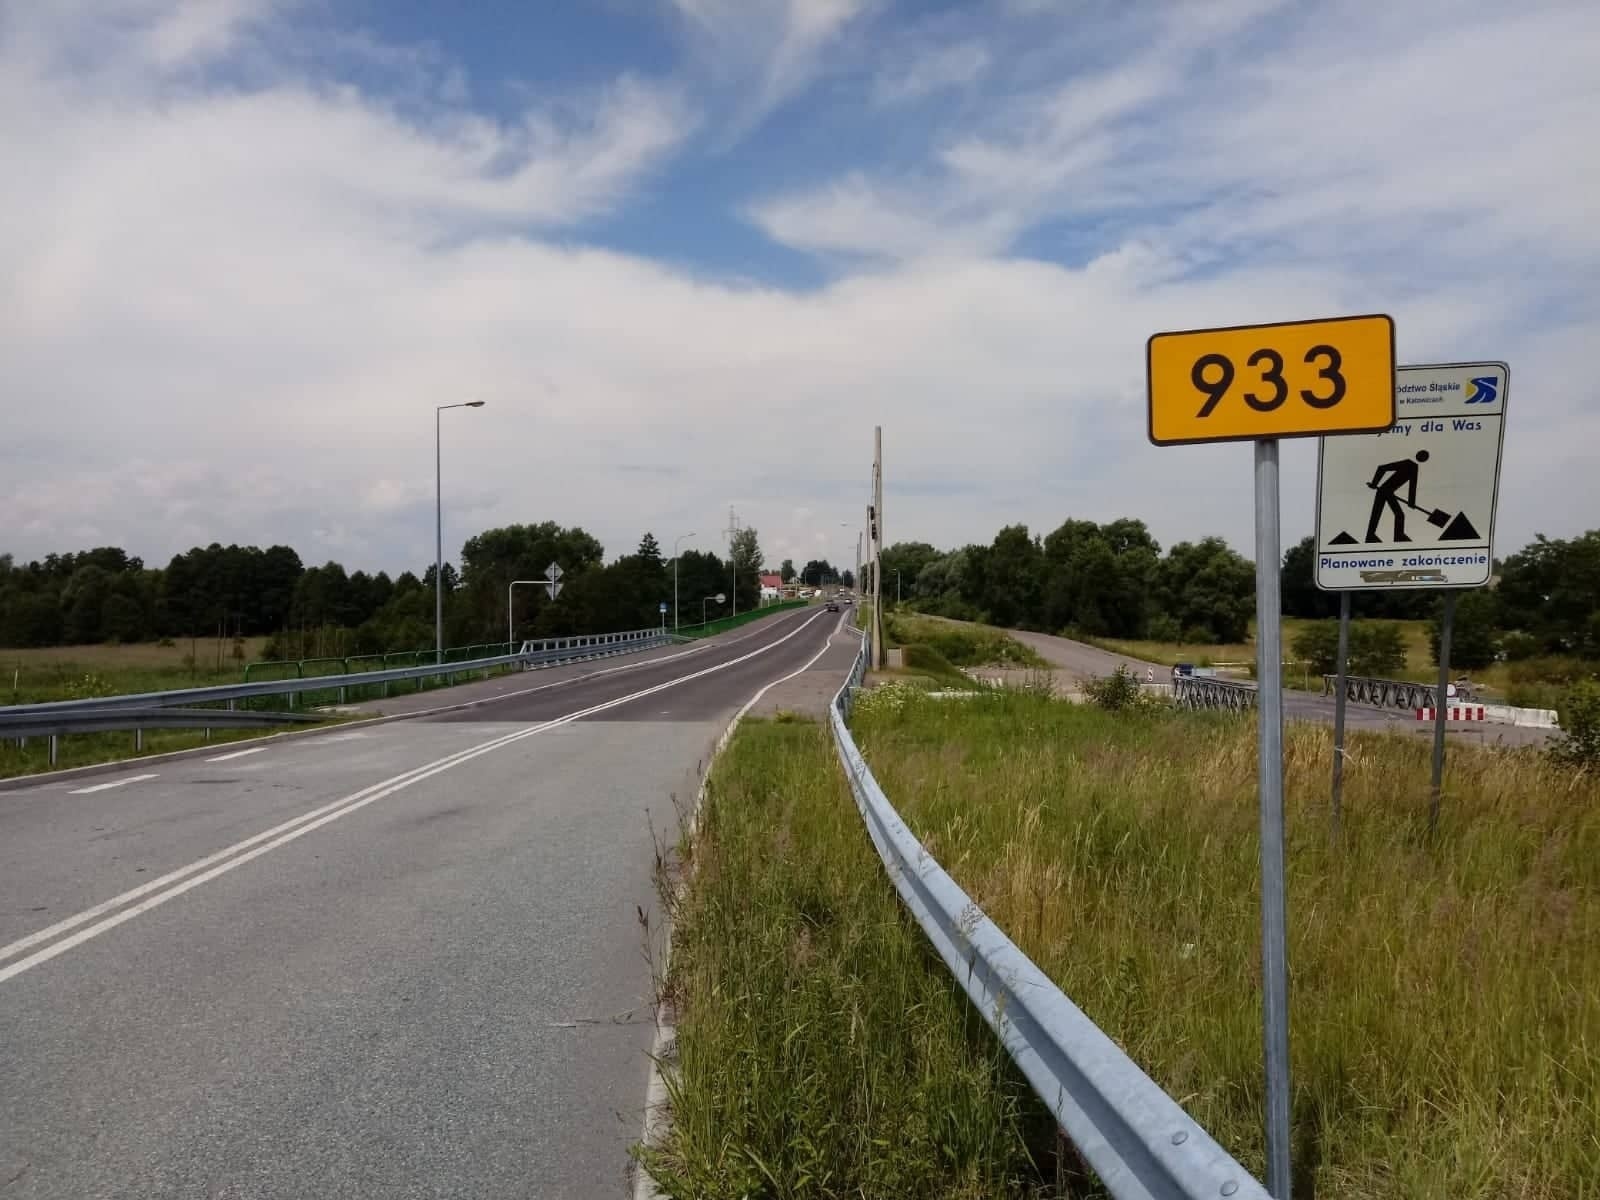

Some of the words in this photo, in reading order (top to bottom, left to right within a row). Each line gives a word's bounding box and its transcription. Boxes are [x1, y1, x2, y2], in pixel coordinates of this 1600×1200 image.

[1191, 345, 1347, 418] 933
[1430, 381, 1460, 392] Śląskie
[1420, 420, 1443, 432] dla
[1452, 418, 1482, 431] Was
[1320, 557, 1394, 569] Planowane
[1402, 552, 1487, 566] zakończenie
